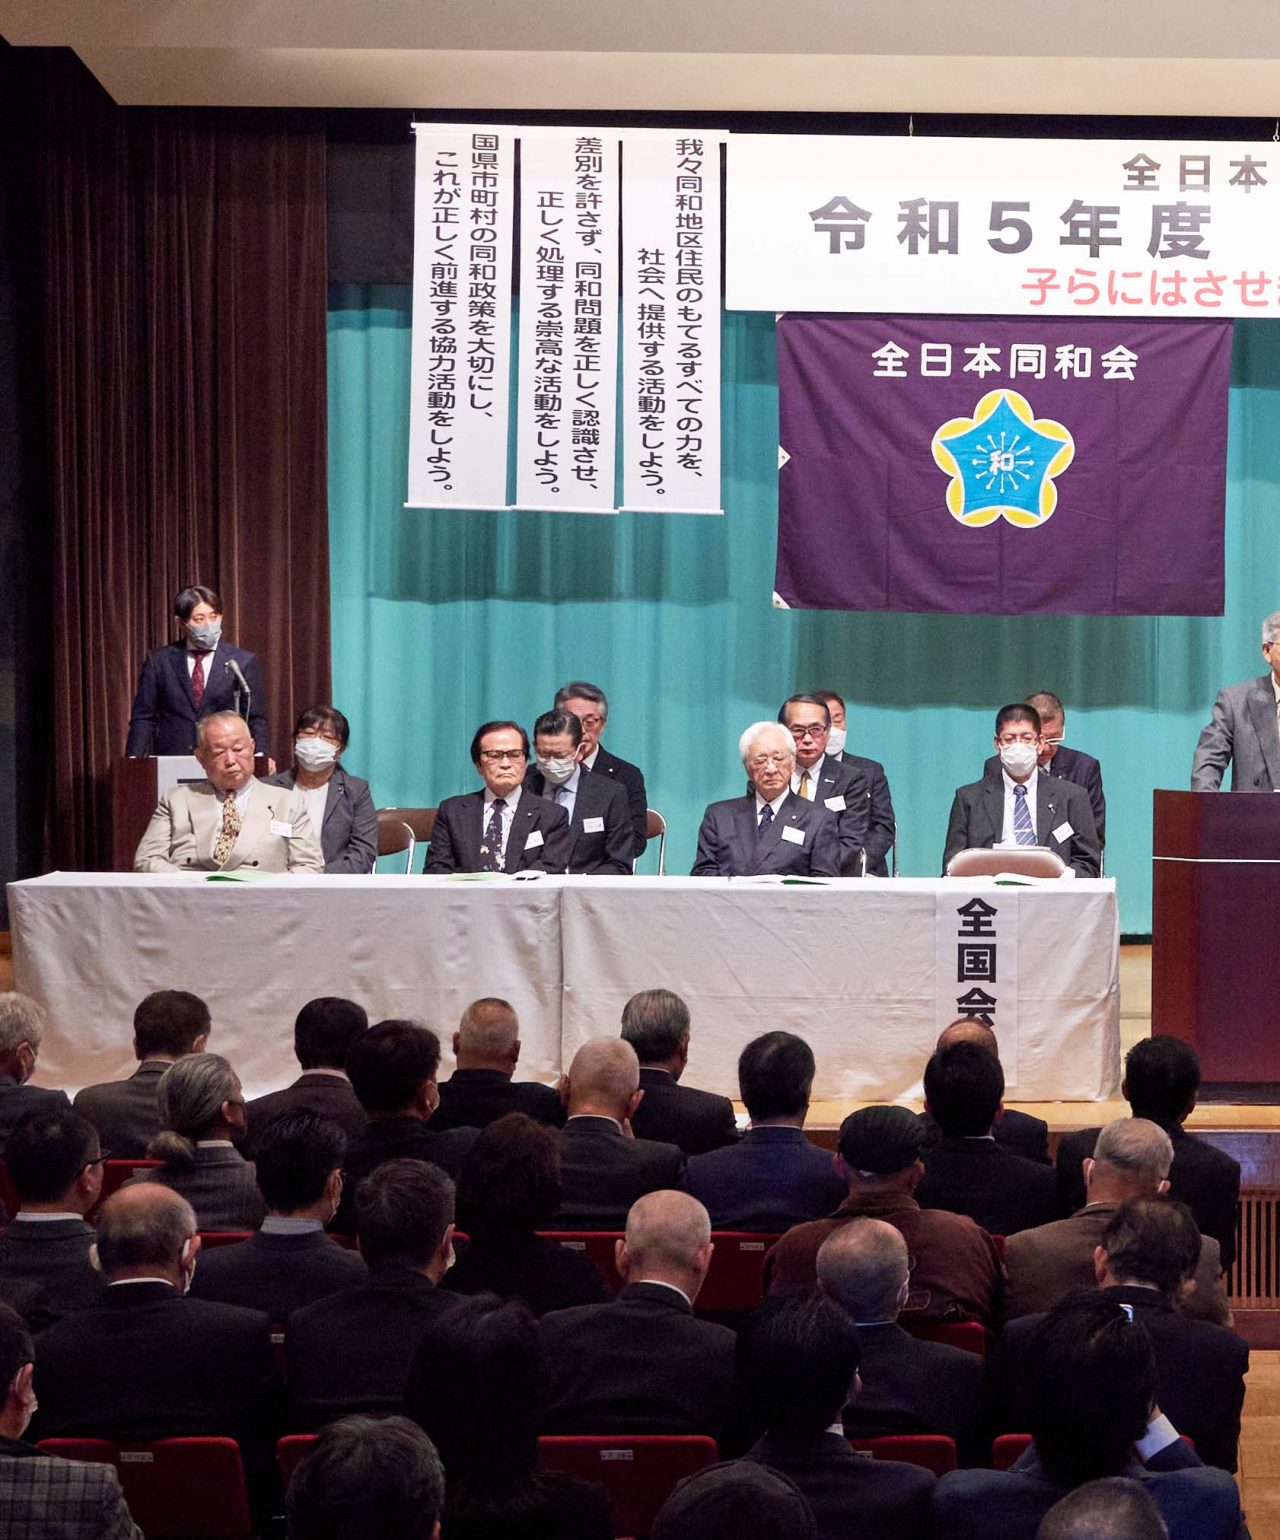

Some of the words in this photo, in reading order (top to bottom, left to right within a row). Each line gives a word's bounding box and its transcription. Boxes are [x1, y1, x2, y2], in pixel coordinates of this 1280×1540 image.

[872, 341, 1138, 380] 全日本同和会
[990, 450, 1015, 475] 和
